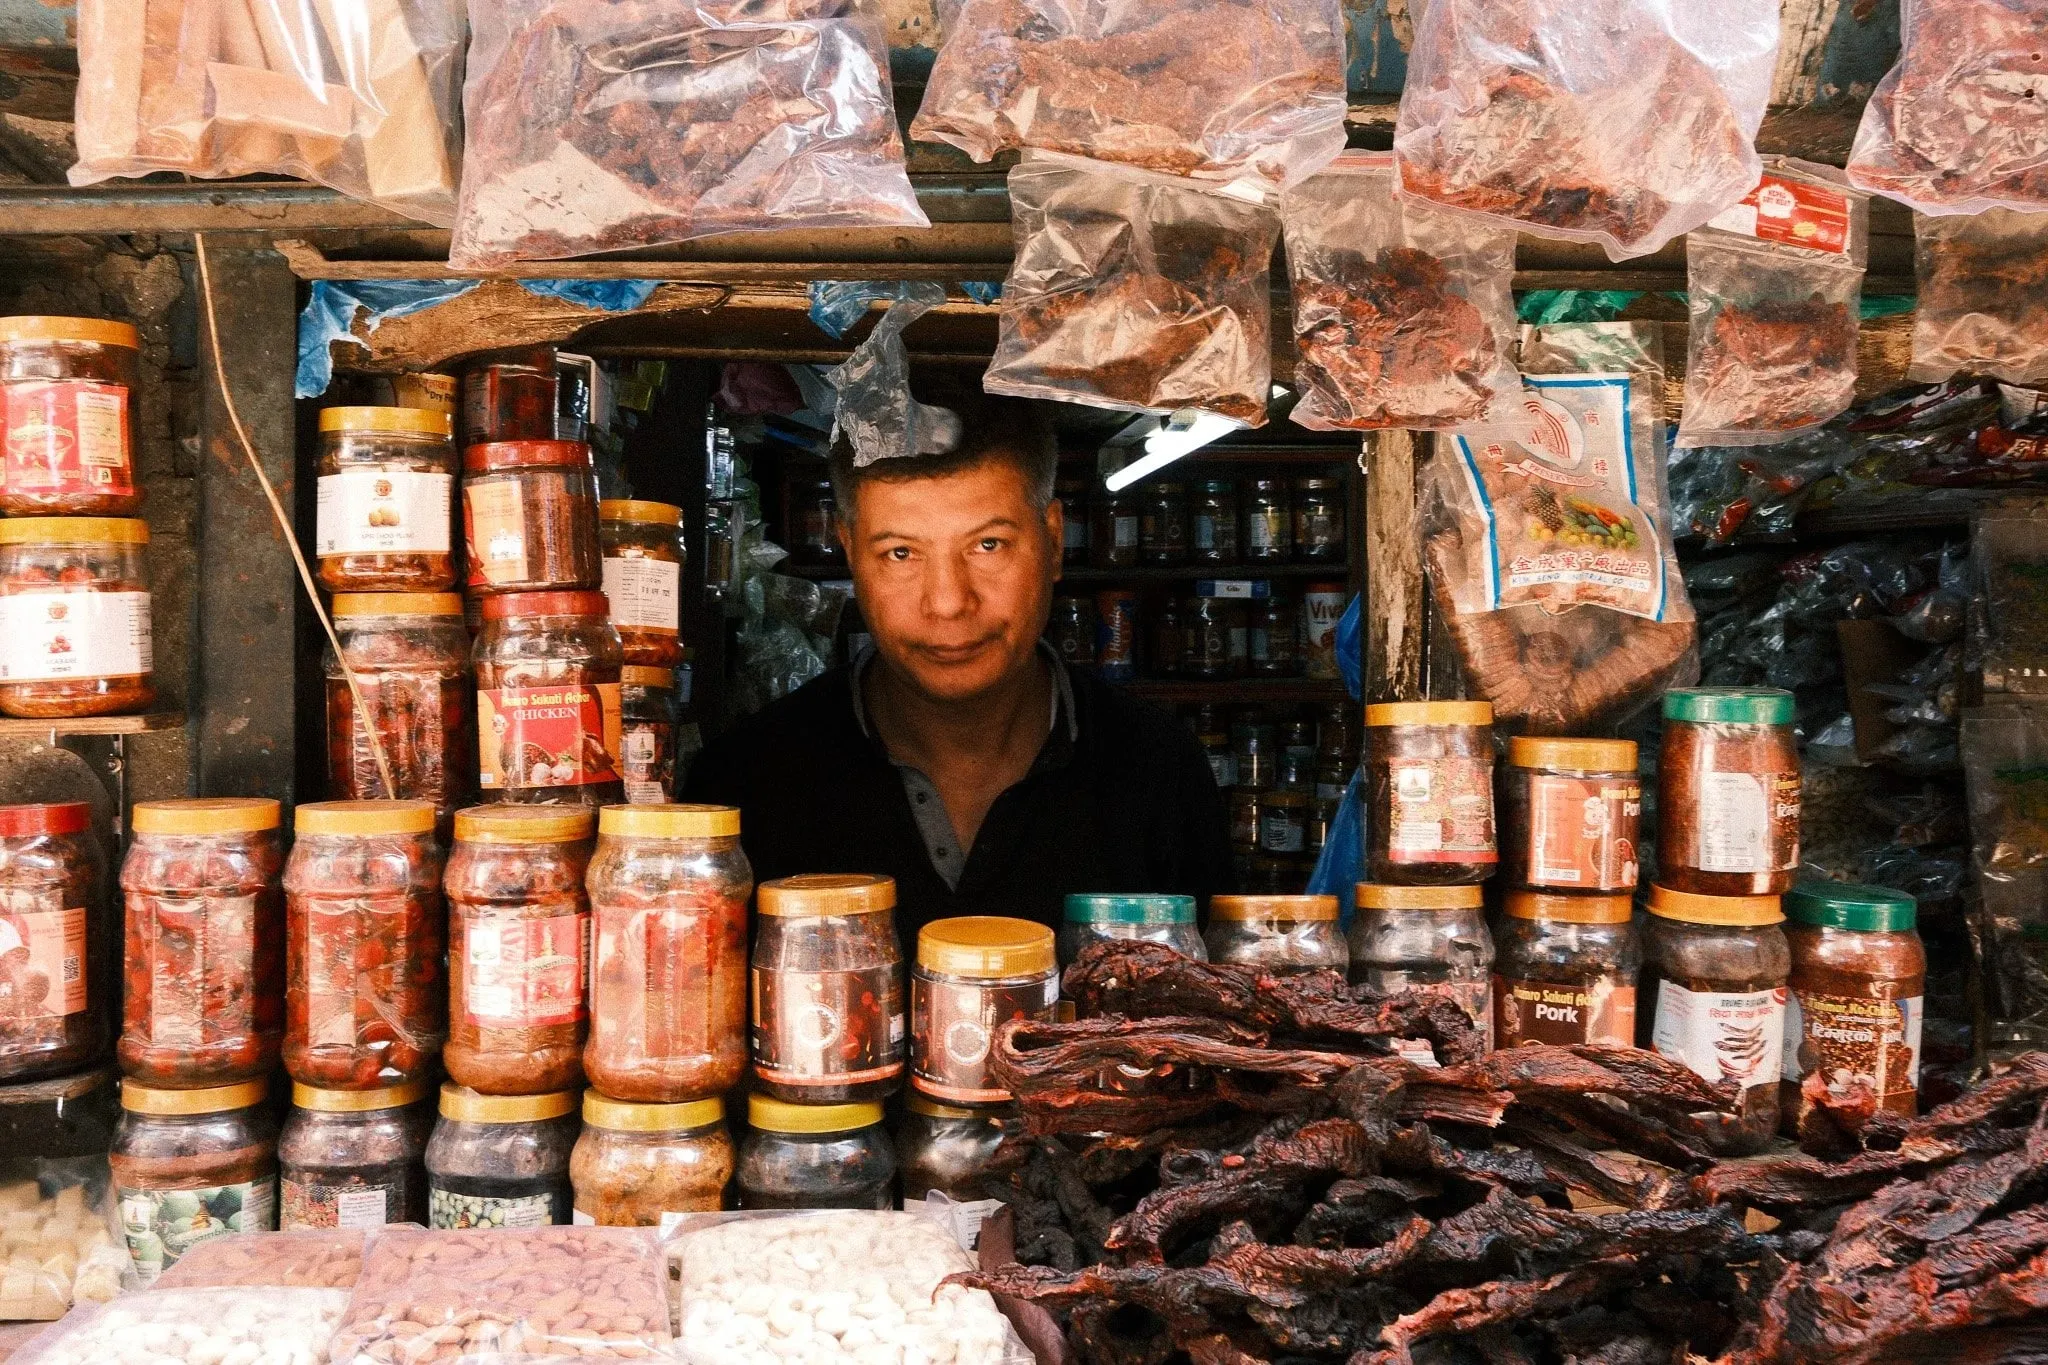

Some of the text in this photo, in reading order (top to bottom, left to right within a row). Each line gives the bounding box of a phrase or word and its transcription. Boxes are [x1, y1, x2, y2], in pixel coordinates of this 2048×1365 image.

[530, 693, 561, 706] Sukuti
[565, 692, 590, 704] Achar
[513, 707, 578, 721] CHICKEN
[1622, 801, 1640, 817] Por
[1543, 990, 1574, 1005] Sukuti
[1536, 1003, 1579, 1023] Pork
